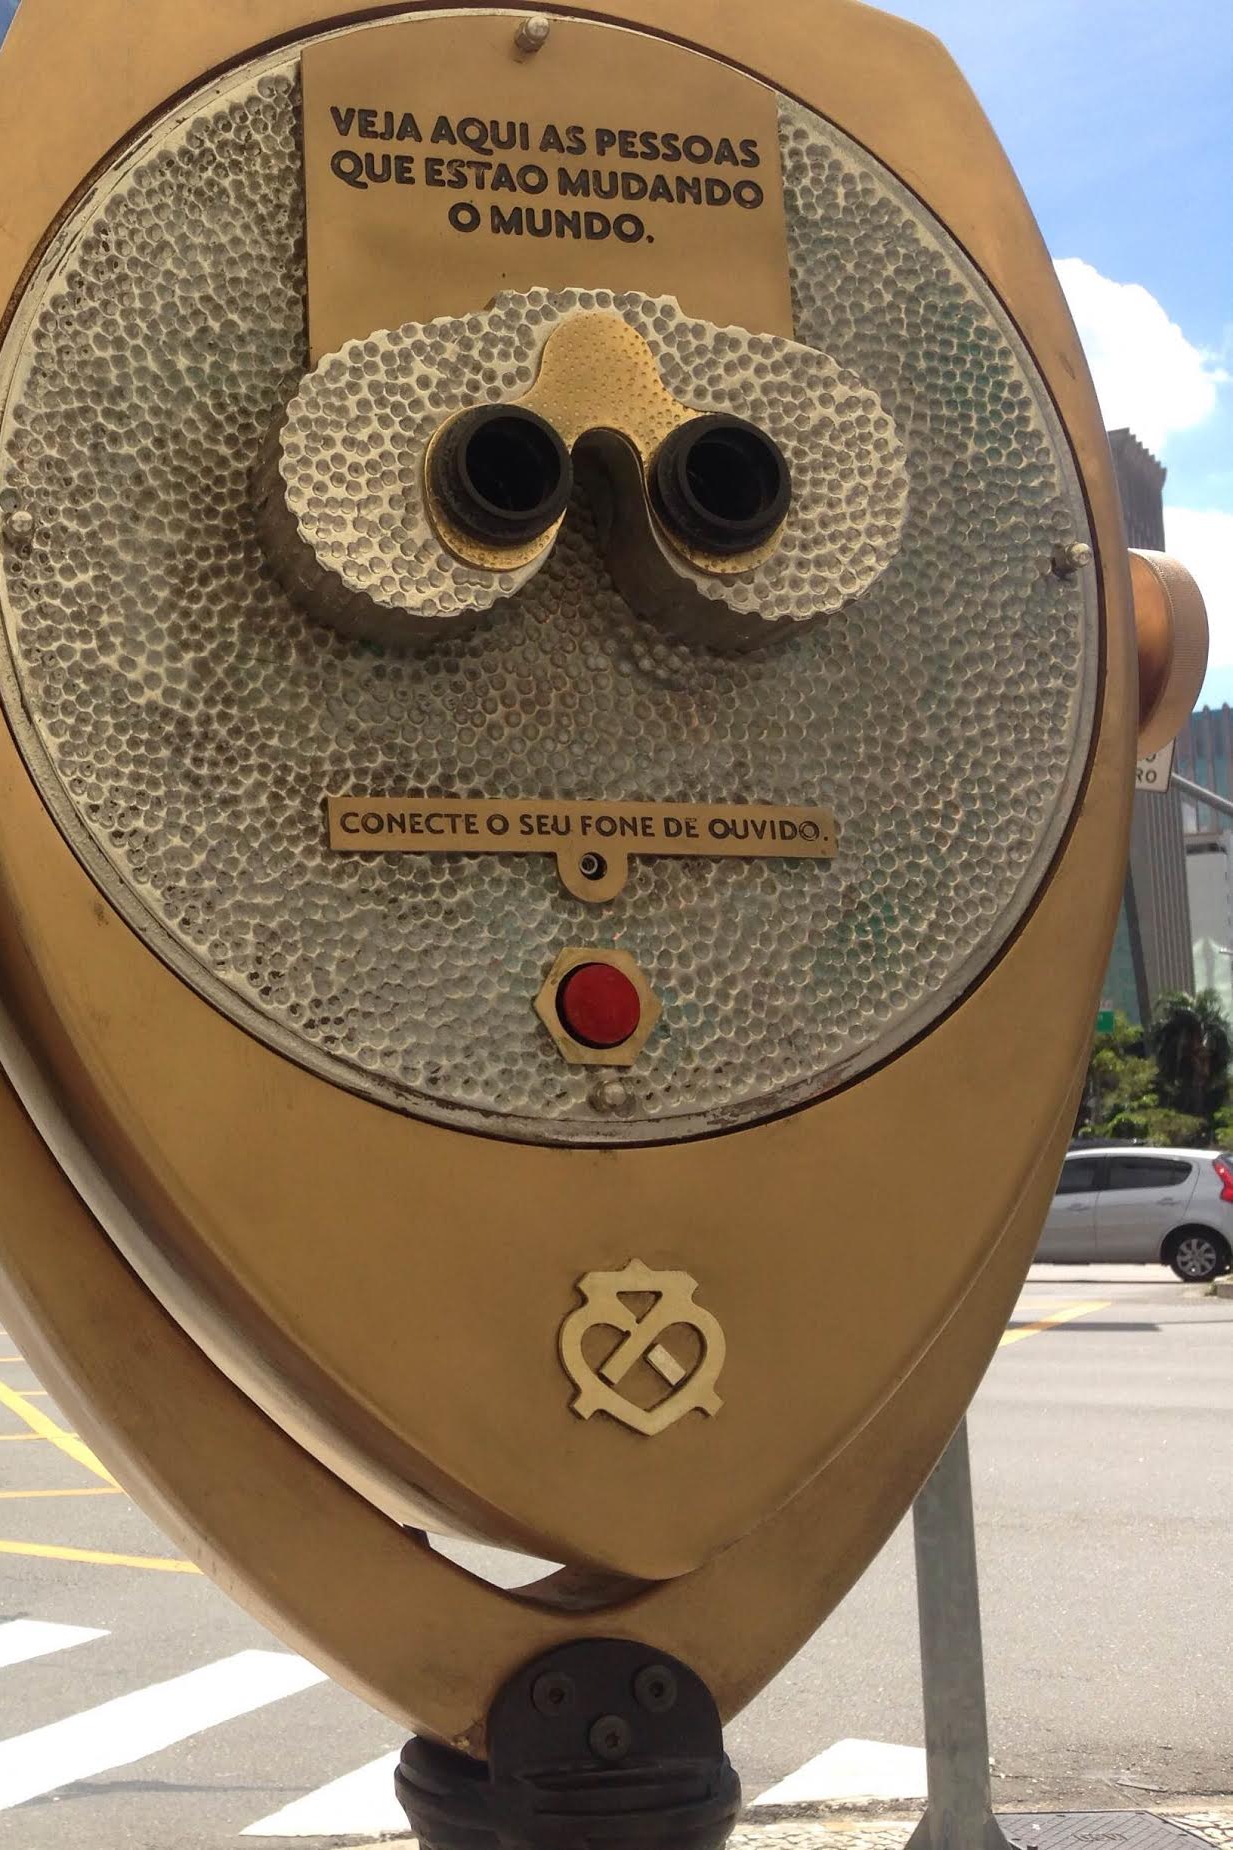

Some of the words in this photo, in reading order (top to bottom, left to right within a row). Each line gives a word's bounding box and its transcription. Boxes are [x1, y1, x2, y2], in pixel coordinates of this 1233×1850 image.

[329, 105, 422, 144] VEJA
[430, 115, 530, 157] AQUI
[538, 123, 586, 156] AS
[595, 127, 761, 169] PESSOAS
[330, 149, 416, 190] QUE
[424, 156, 549, 195] ESTAO
[557, 166, 764, 210] MUDANDO
[448, 202, 481, 234] O
[490, 204, 655, 245] MUNDO.
[339, 811, 479, 836] CONECTE
[486, 812, 510, 836] O
[519, 813, 570, 837] SEU
[580, 814, 657, 839] FONE
[664, 816, 700, 839] DE
[707, 816, 831, 843] OUVIDO.
